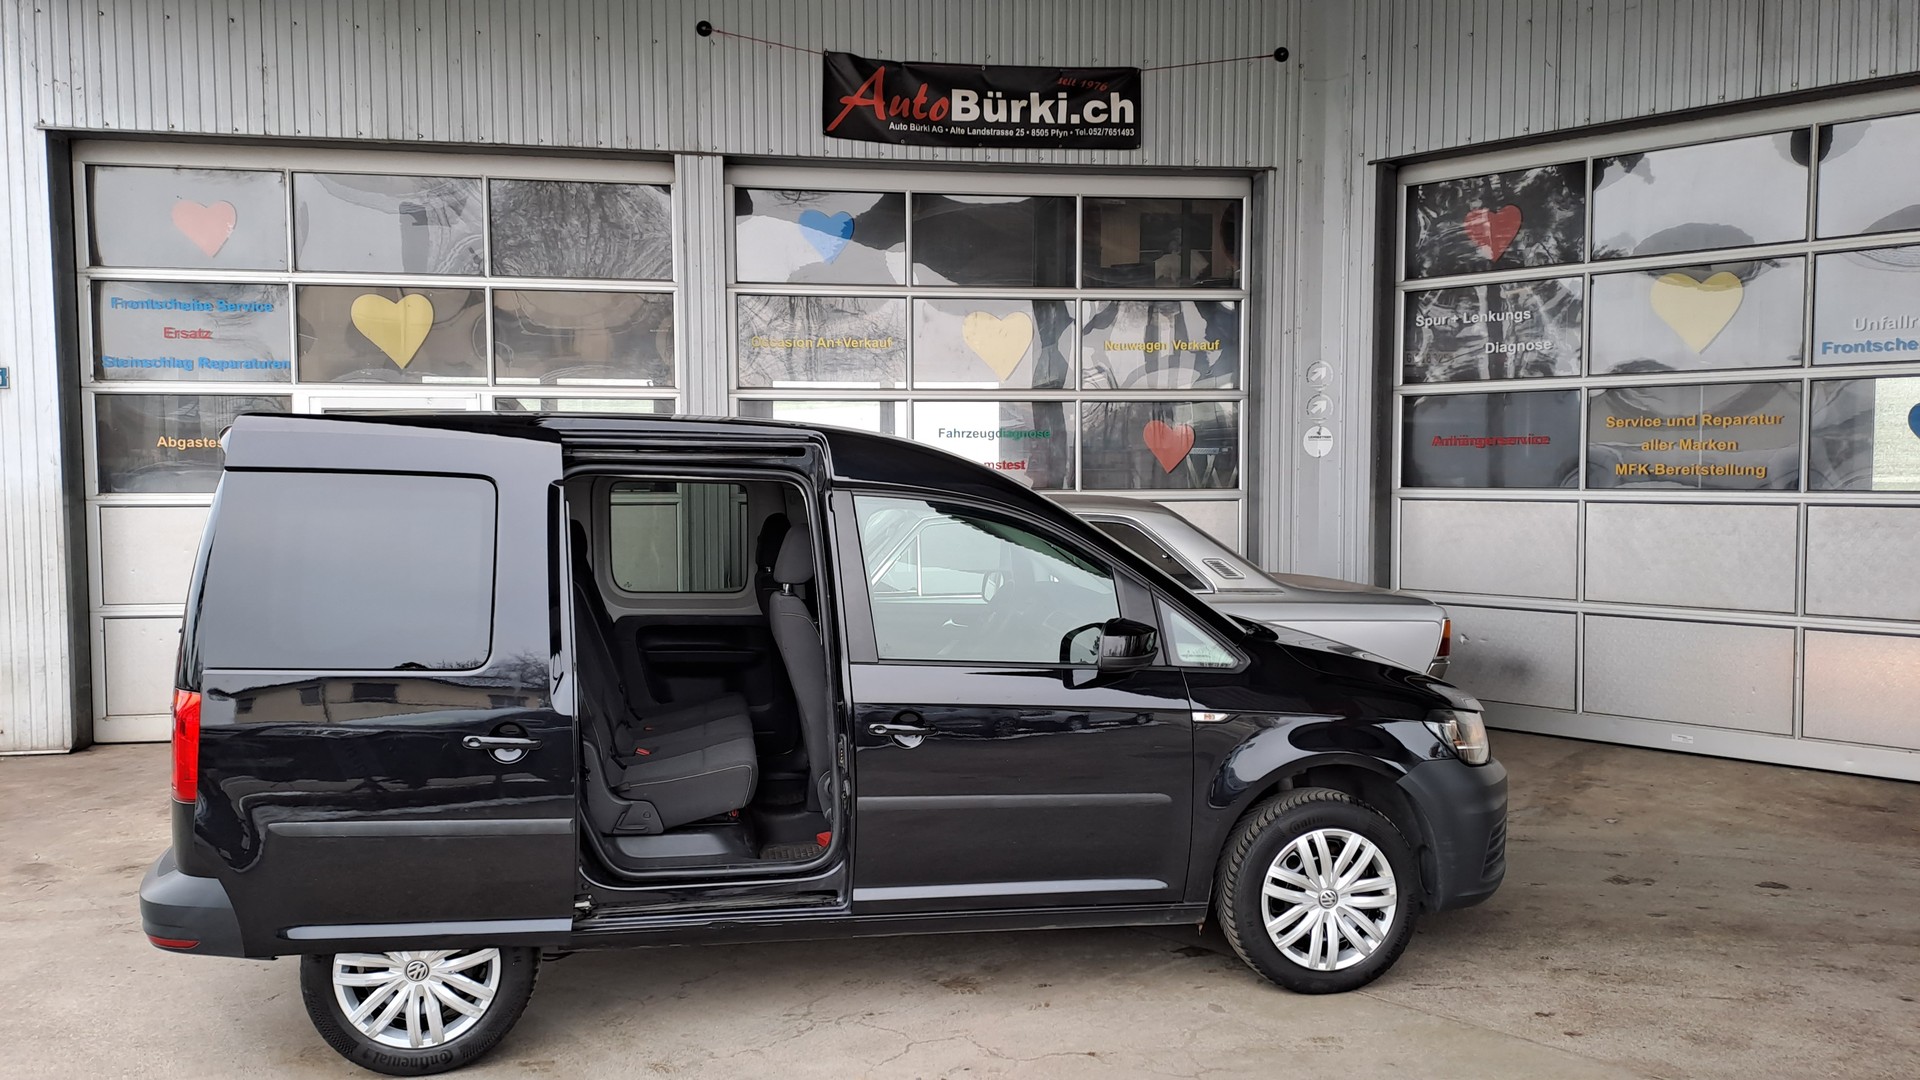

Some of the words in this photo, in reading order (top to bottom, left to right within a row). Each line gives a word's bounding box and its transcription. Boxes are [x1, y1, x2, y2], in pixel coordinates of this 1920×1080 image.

[1080, 79, 1109, 92] 1976
[889, 122, 908, 131] Auto
[909, 123, 930, 132] Bürki
[931, 125, 944, 133] AG
[950, 126, 965, 135] Alte
[967, 127, 1014, 136] Landstrasse
[1015, 128, 1025, 136] 25
[1031, 128, 1049, 137] 8505
[1050, 128, 1068, 139] Pfyn
[111, 297, 214, 313] Frontscheibe
[215, 300, 274, 313] Service
[1415, 315, 1448, 329] Spur
[1462, 310, 1531, 324] Lenkungs
[1853, 314, 1920, 332] Unfallr
[163, 326, 214, 340] Ersatz
[751, 336, 814, 349] Occasion
[816, 336, 894, 349] An+Verkauf
[1103, 339, 1169, 353] Neuwagen
[1172, 339, 1221, 351] Verkauf
[1485, 340, 1553, 355] Diagnose
[1821, 337, 1919, 355] Frontsche
[102, 356, 195, 371] Steinschlag
[198, 357, 291, 372] Reparaturen
[1605, 415, 1662, 428] Service
[1666, 414, 1697, 427] und
[1701, 413, 1785, 429] Reparatur
[937, 427, 1051, 441] Fahrzeugdiagnose
[1431, 434, 1551, 449] Anhängerservice
[1641, 439, 1676, 451] aller
[1678, 438, 1739, 451] Marken
[1615, 462, 1768, 479] MFK-Bereitstellung
[372, 1049, 454, 1070] Continental
